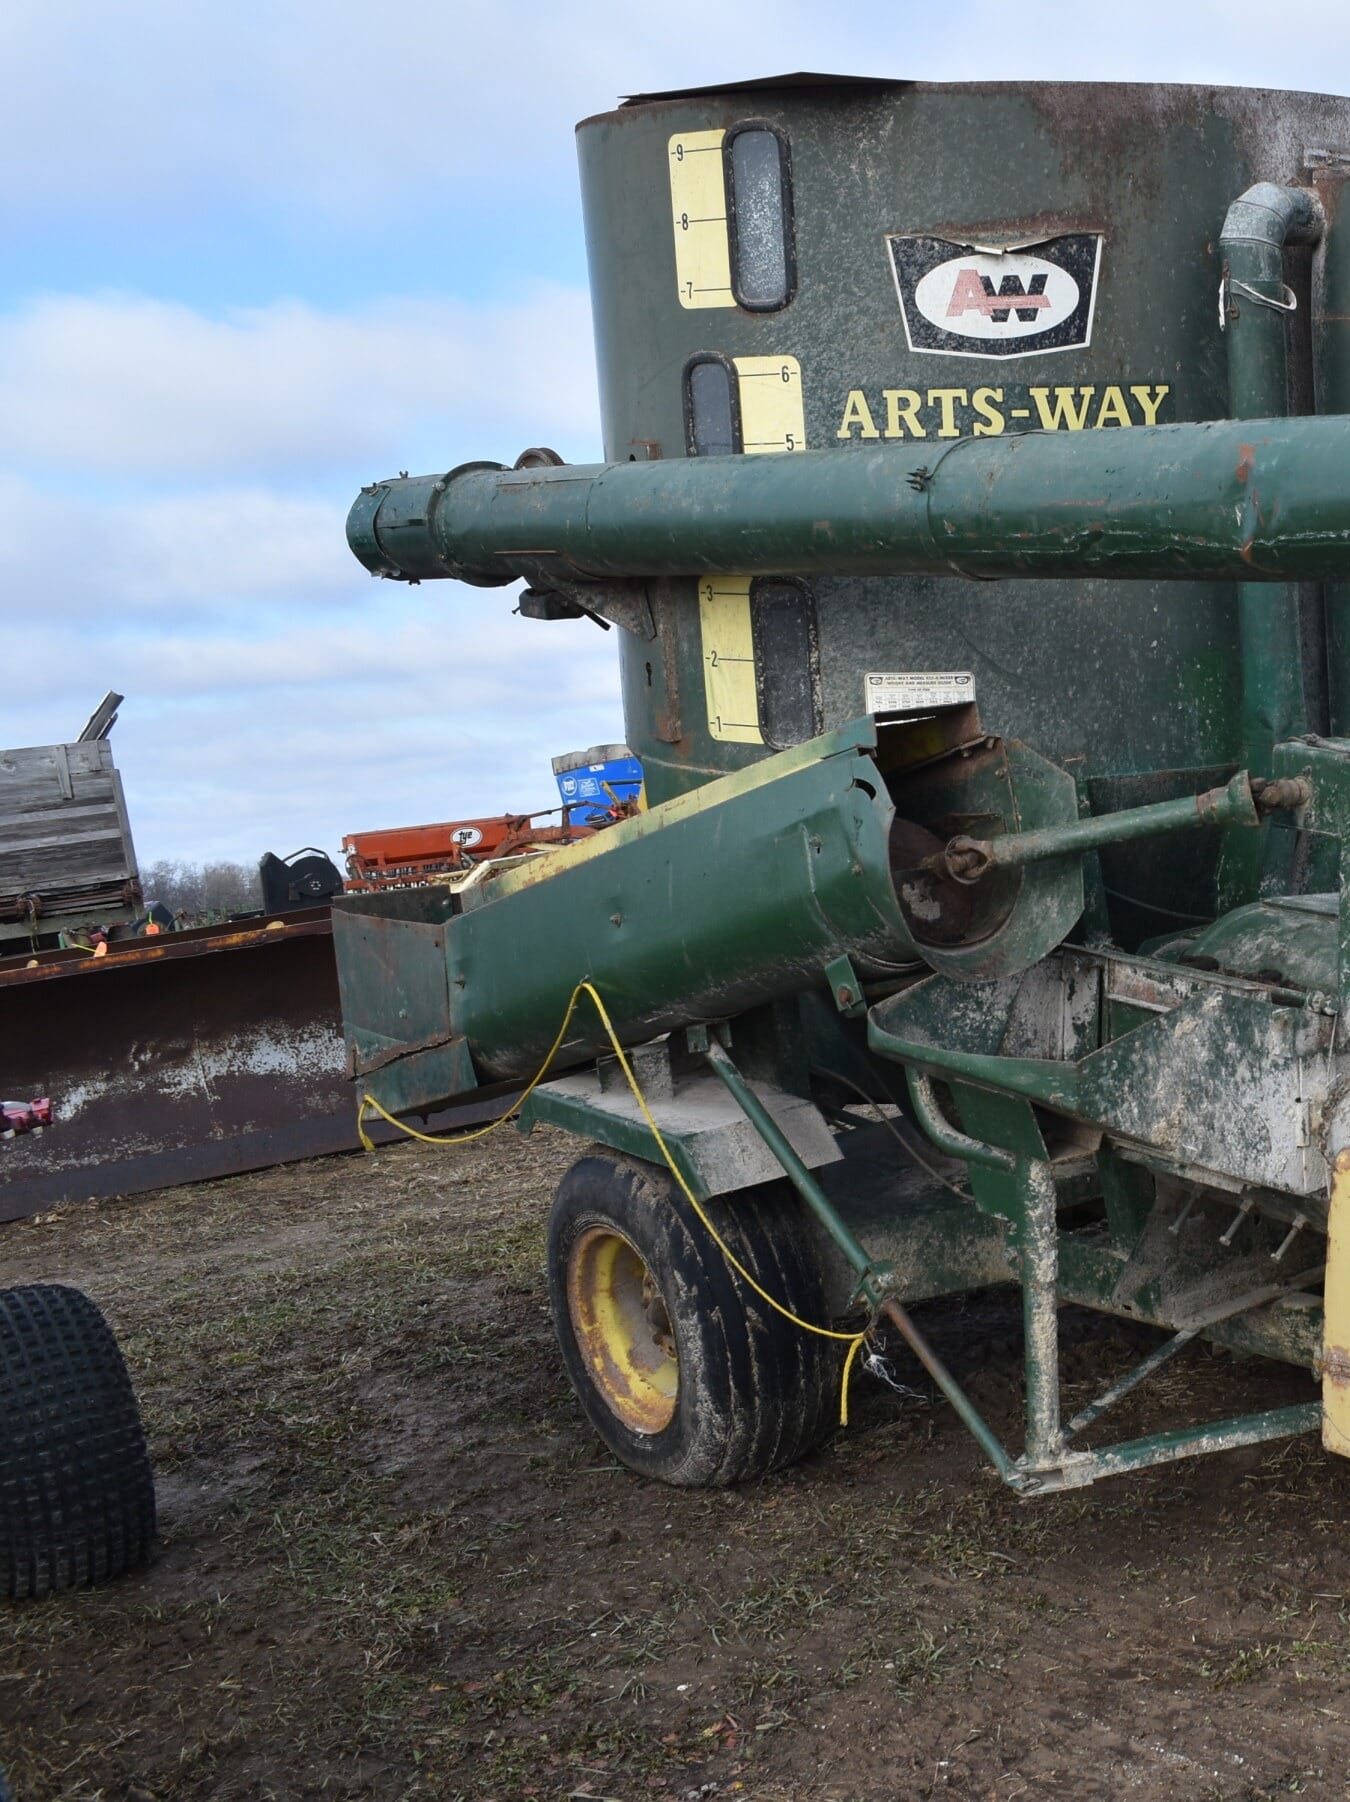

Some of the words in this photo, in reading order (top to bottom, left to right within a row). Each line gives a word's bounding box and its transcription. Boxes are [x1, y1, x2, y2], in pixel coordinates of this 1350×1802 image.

[676, 143, 684, 161] 9
[681, 212, 689, 231] 8
[686, 281, 693, 299] 7
[781, 365, 790, 383] 6
[837, 385, 1170, 438] ARTS-WAY
[785, 433, 795, 451] 5
[706, 584, 713, 602] 3
[711, 650, 718, 668] 2
[716, 715, 722, 732] 1
